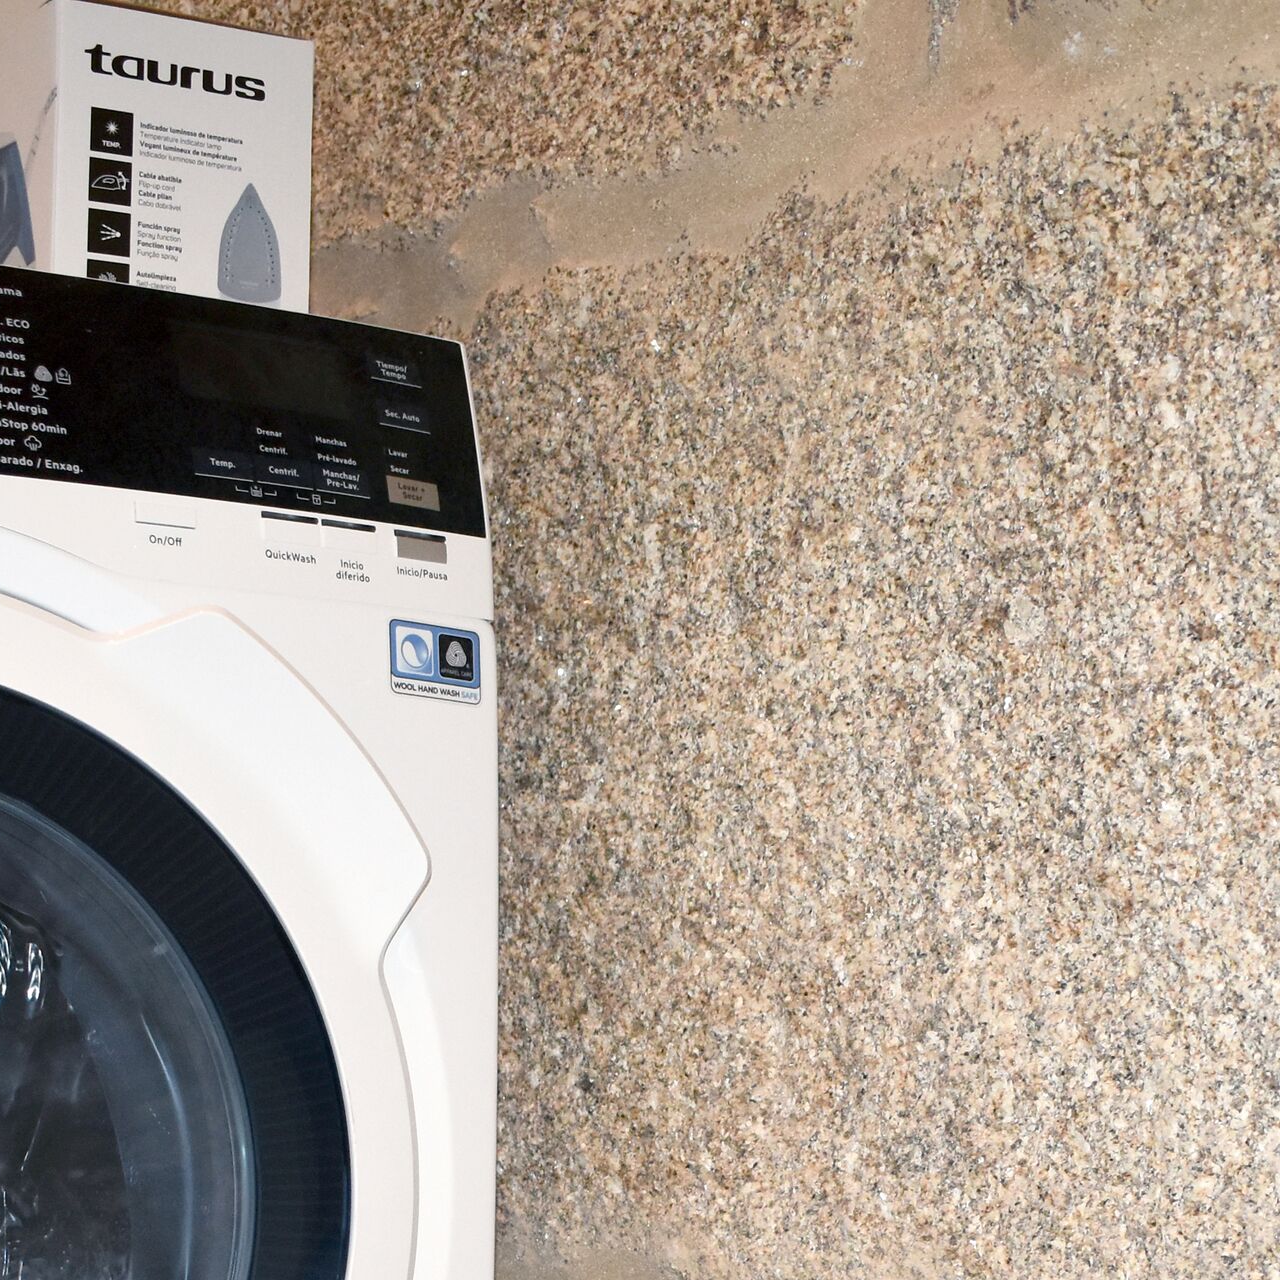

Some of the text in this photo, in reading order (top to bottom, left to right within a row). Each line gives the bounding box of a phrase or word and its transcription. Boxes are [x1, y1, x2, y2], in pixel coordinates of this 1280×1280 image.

[85, 44, 266, 101] taurus
[140, 122, 169, 132] Indicador
[170, 127, 197, 137] luminoso
[207, 133, 243, 144] temperatura
[140, 131, 179, 143] Temperature
[140, 150, 167, 160] Indicador
[206, 161, 242, 172] temperatura
[139, 171, 157, 180] Cable
[138, 221, 180, 234] Función spray
[137, 230, 155, 240] Spray
[137, 240, 182, 253] Fonction spray
[161, 253, 178, 262] spray
[6, 318, 30, 329] ECO
[402, 412, 420, 423] Auto
[31, 421, 68, 435] 60min
[256, 427, 283, 438] Drenar
[315, 436, 347, 448] Manchas
[259, 444, 288, 456] Centrif.
[388, 449, 408, 458] Lavar
[36, 457, 42, 469] /
[44, 459, 84, 474] Enxag.
[209, 457, 236, 470] Temp.
[390, 465, 409, 475] Secar
[269, 465, 300, 477] Centrif.
[322, 469, 360, 482] Manchas/
[149, 534, 183, 548] On/Off
[265, 549, 317, 565] QuickWash
[340, 559, 364, 571] Inicio
[336, 569, 371, 584] diferido
[396, 566, 448, 582] Inicio/Pausa
[394, 681, 416, 691] WOOL
[418, 686, 438, 694] HAND
[439, 688, 460, 697] WASH
